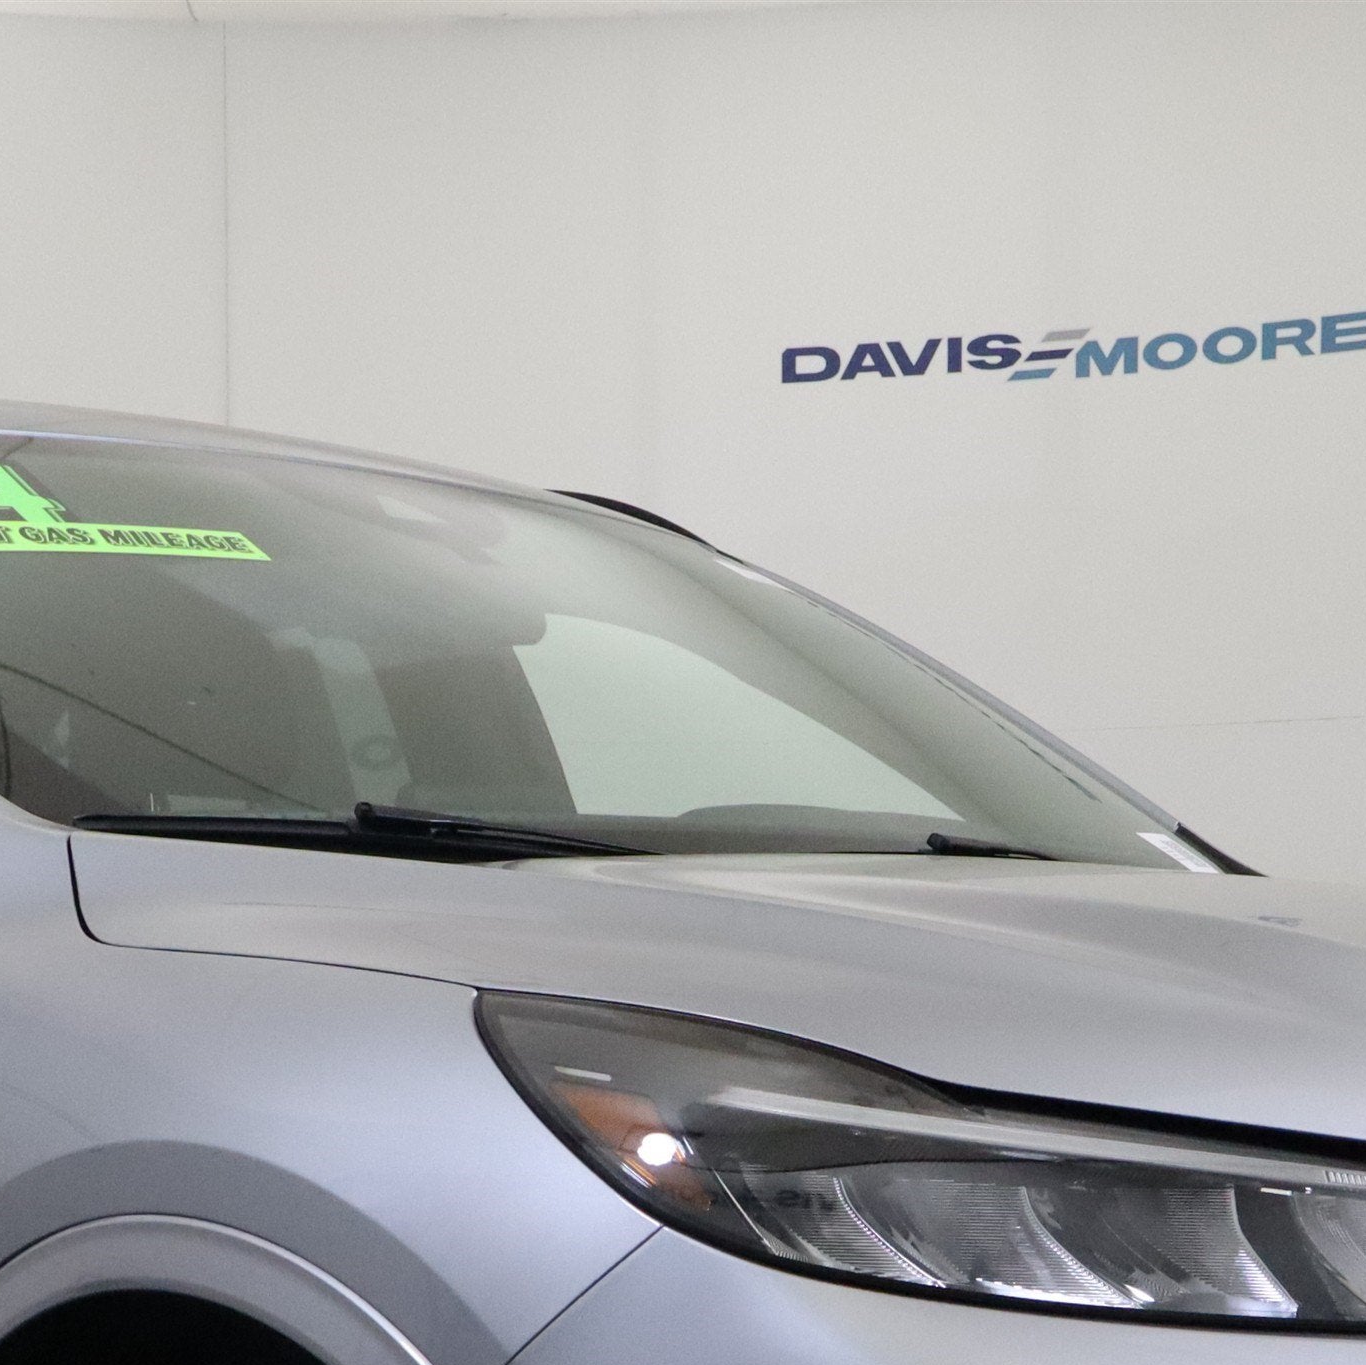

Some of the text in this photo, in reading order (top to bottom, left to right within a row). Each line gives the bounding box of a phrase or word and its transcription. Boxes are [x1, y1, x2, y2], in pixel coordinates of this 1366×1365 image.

[781, 333, 1023, 384] DAVIS
[18, 526, 95, 545] GAS
[97, 528, 255, 554] MILEAGE
